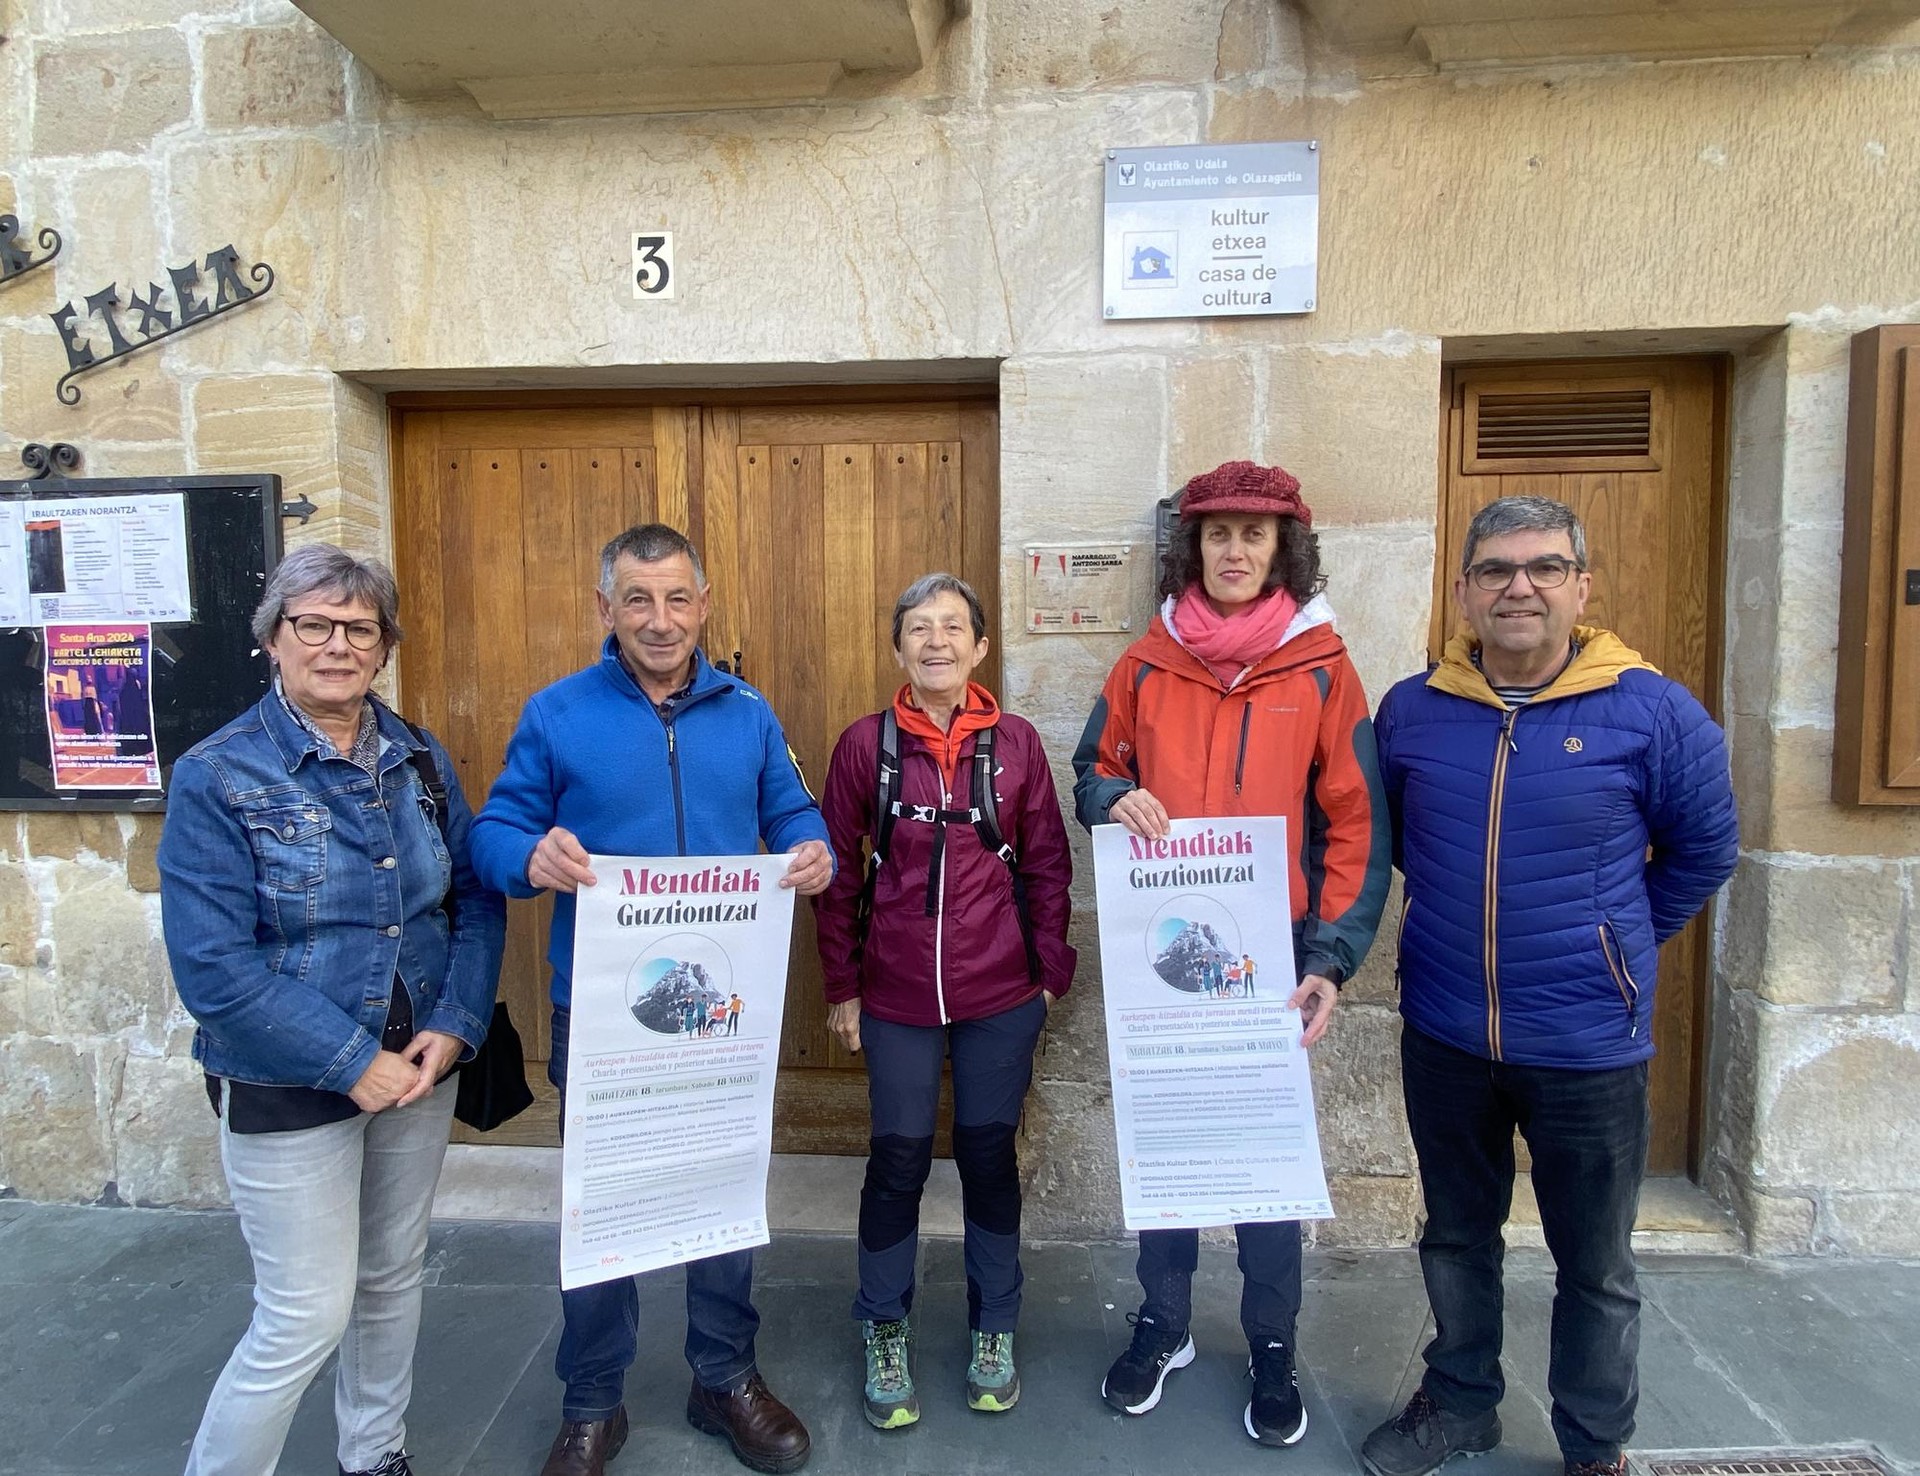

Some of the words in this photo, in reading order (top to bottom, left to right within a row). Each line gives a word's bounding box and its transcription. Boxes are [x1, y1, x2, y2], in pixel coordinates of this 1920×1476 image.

[1143, 160, 1189, 172] Olaztiko
[1143, 175, 1219, 190] Ayuntamiento
[1224, 174, 1238, 185] de
[1211, 208, 1270, 226] kultur
[1211, 233, 1267, 250] etxea
[636, 236, 670, 294] 3
[1198, 267, 1245, 282] casa
[1252, 263, 1277, 281] de
[1202, 288, 1272, 307] cultura
[48, 244, 253, 371] ETXEA
[32, 508, 88, 518] IRAULTZAREN
[89, 506, 138, 515] NORANTZA
[60, 633, 85, 643] Santa
[107, 632, 135, 643] 2024
[53, 648, 87, 657] KARTEL
[88, 647, 142, 657] LEHIAKETA
[52, 658, 90, 666] CONCURSO
[91, 658, 103, 666] DE
[104, 657, 144, 668] CARTELES
[1128, 828, 1253, 861] Mendiak
[619, 865, 760, 896] Mendiak
[1129, 862, 1255, 889] Guztiontzat
[617, 899, 757, 926] Guztiontzat
[1246, 1041, 1257, 1051] 18
[717, 1077, 727, 1086] 18
